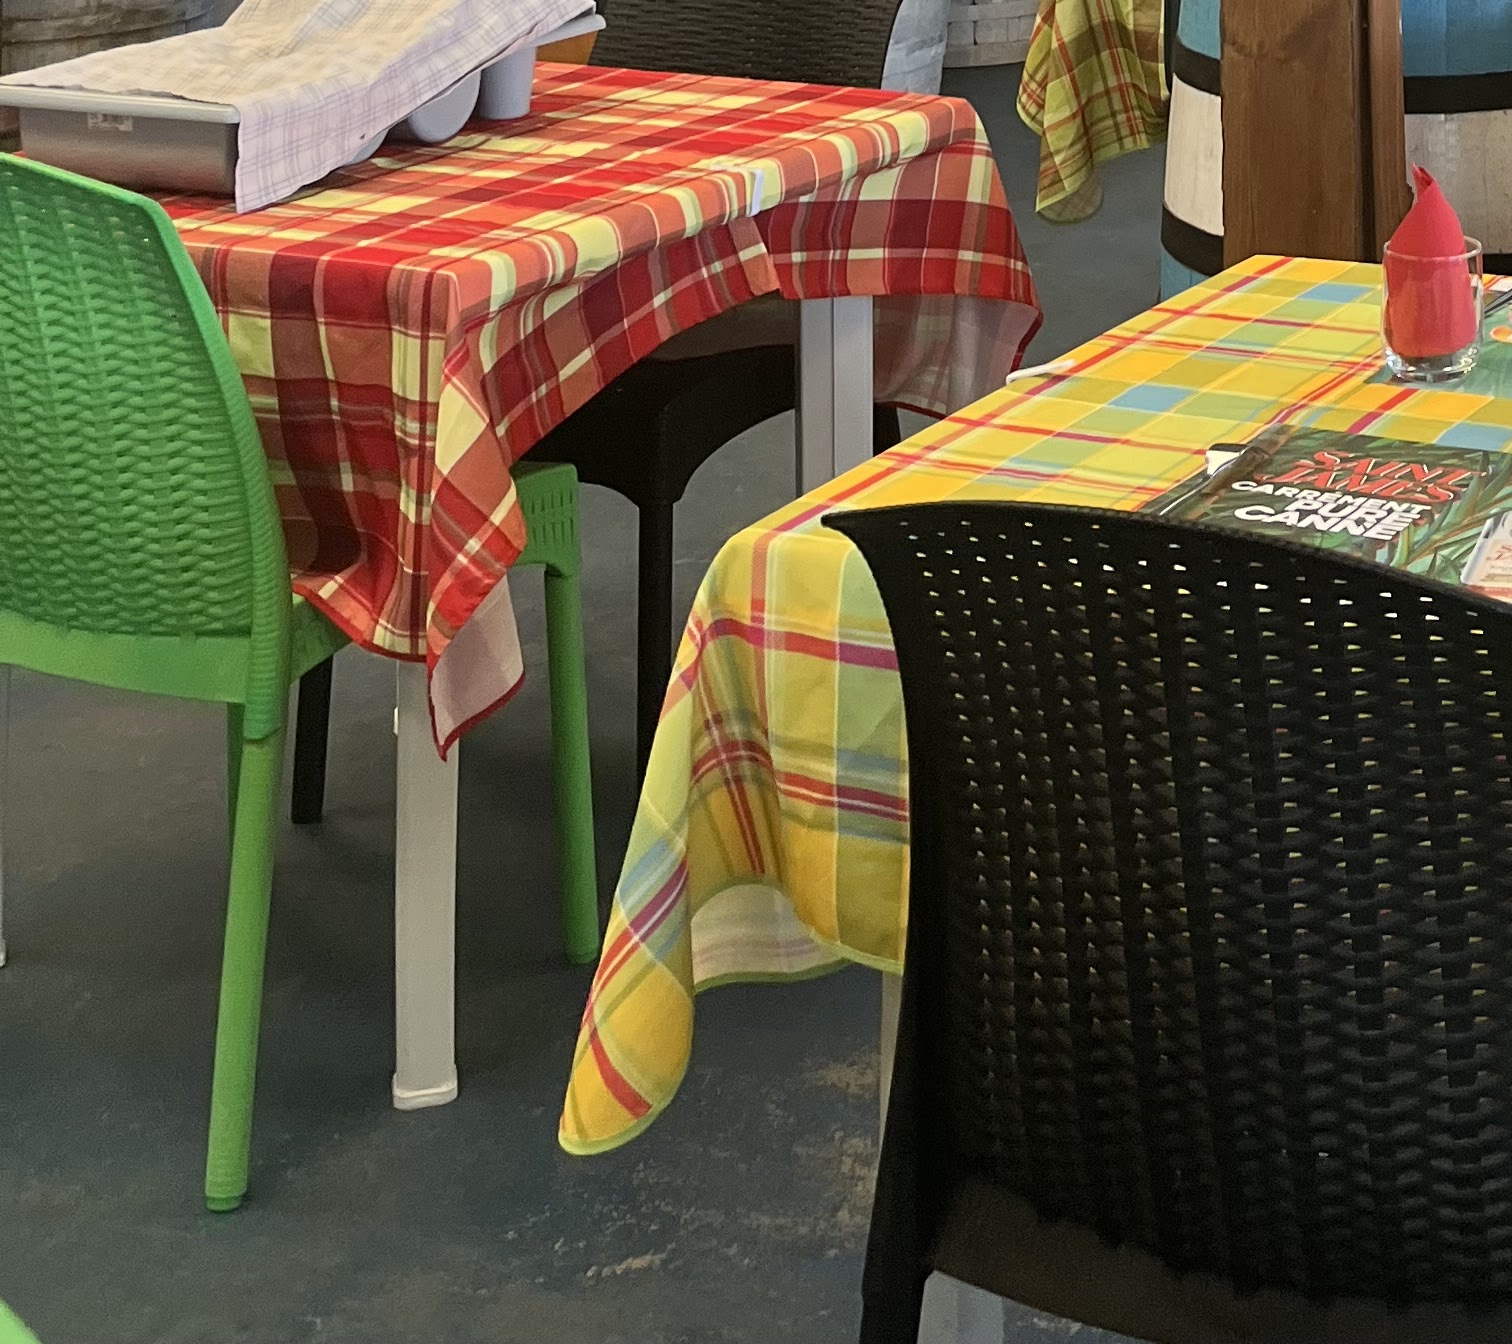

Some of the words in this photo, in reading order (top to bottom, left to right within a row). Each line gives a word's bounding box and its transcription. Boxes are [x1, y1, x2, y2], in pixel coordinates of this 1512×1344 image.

[1254, 467, 1457, 503] JAMES
[1296, 450, 1490, 486] SAINT
[1233, 504, 1408, 541] CANNE
[1284, 498, 1423, 529] PURE
